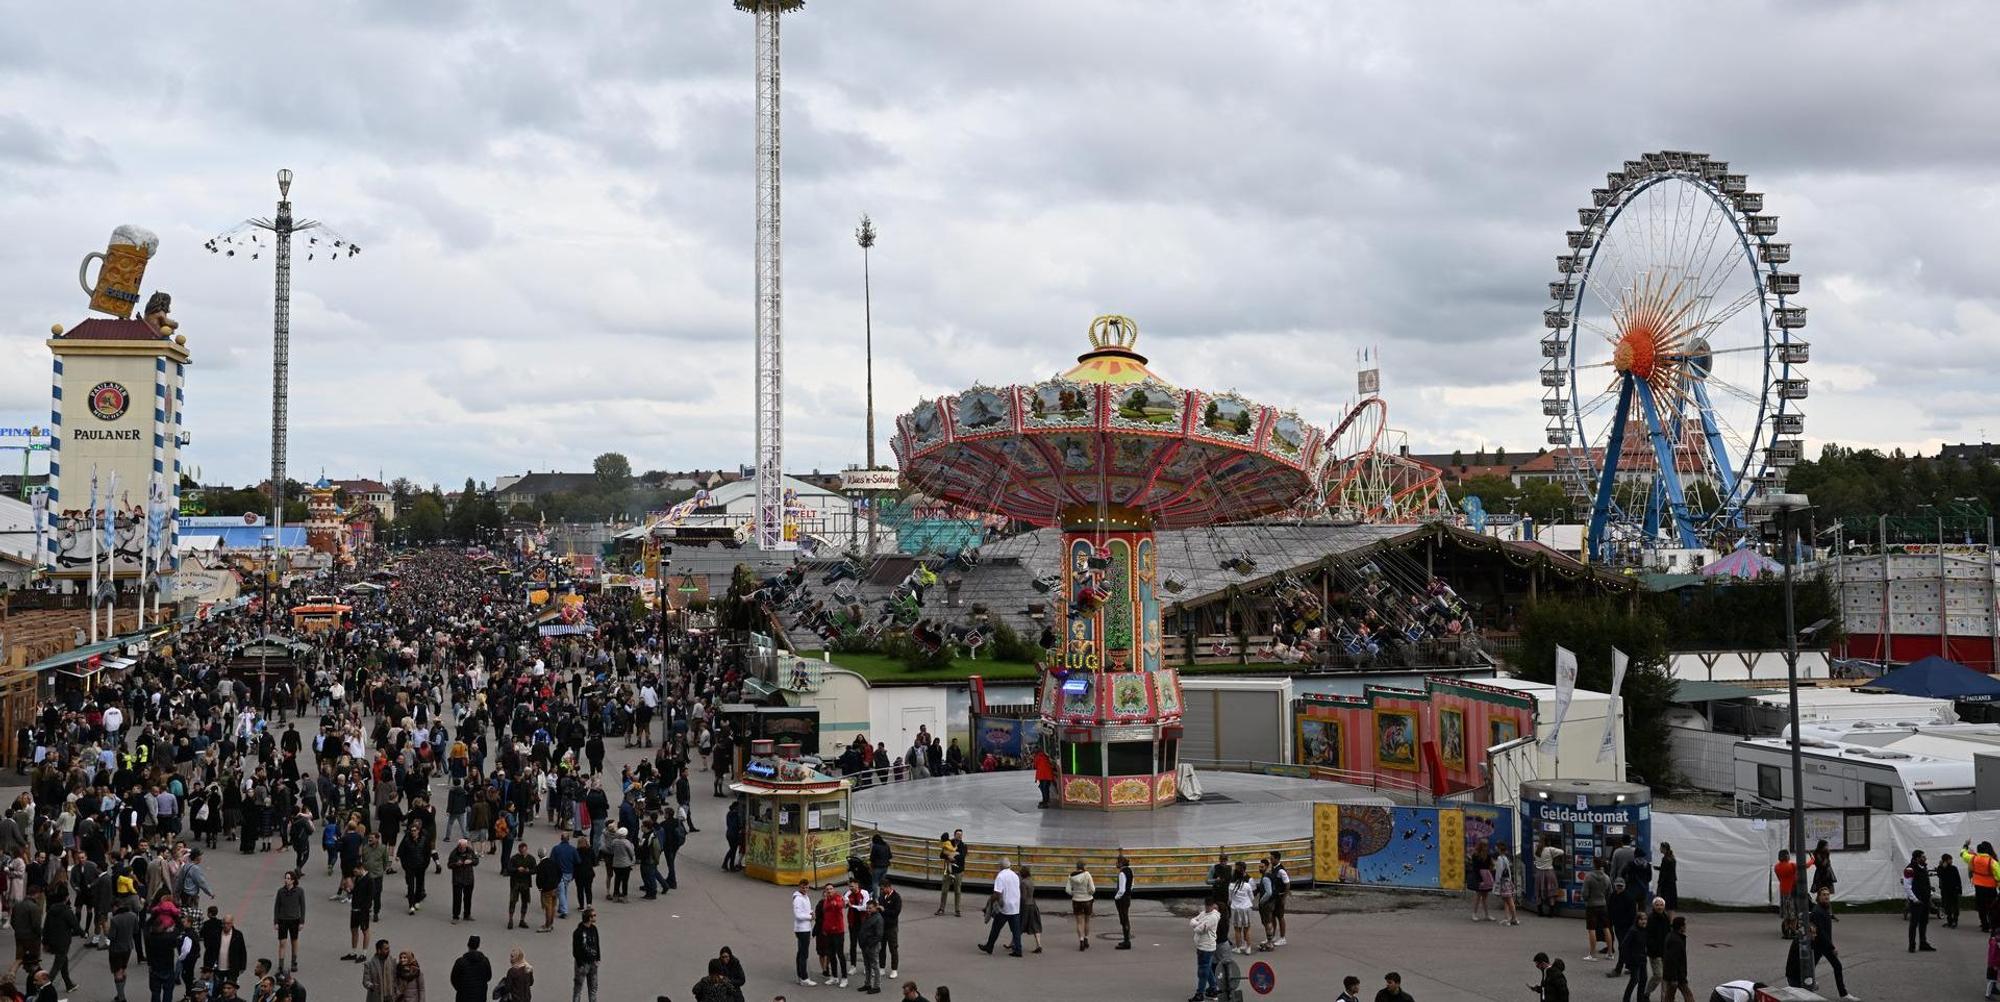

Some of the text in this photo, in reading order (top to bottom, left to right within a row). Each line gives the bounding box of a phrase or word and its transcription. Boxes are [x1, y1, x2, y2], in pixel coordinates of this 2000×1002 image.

[90, 382, 127, 396] PAULANER
[74, 429, 140, 440] PAULANER
[1540, 805, 1629, 823] Geldautomat
